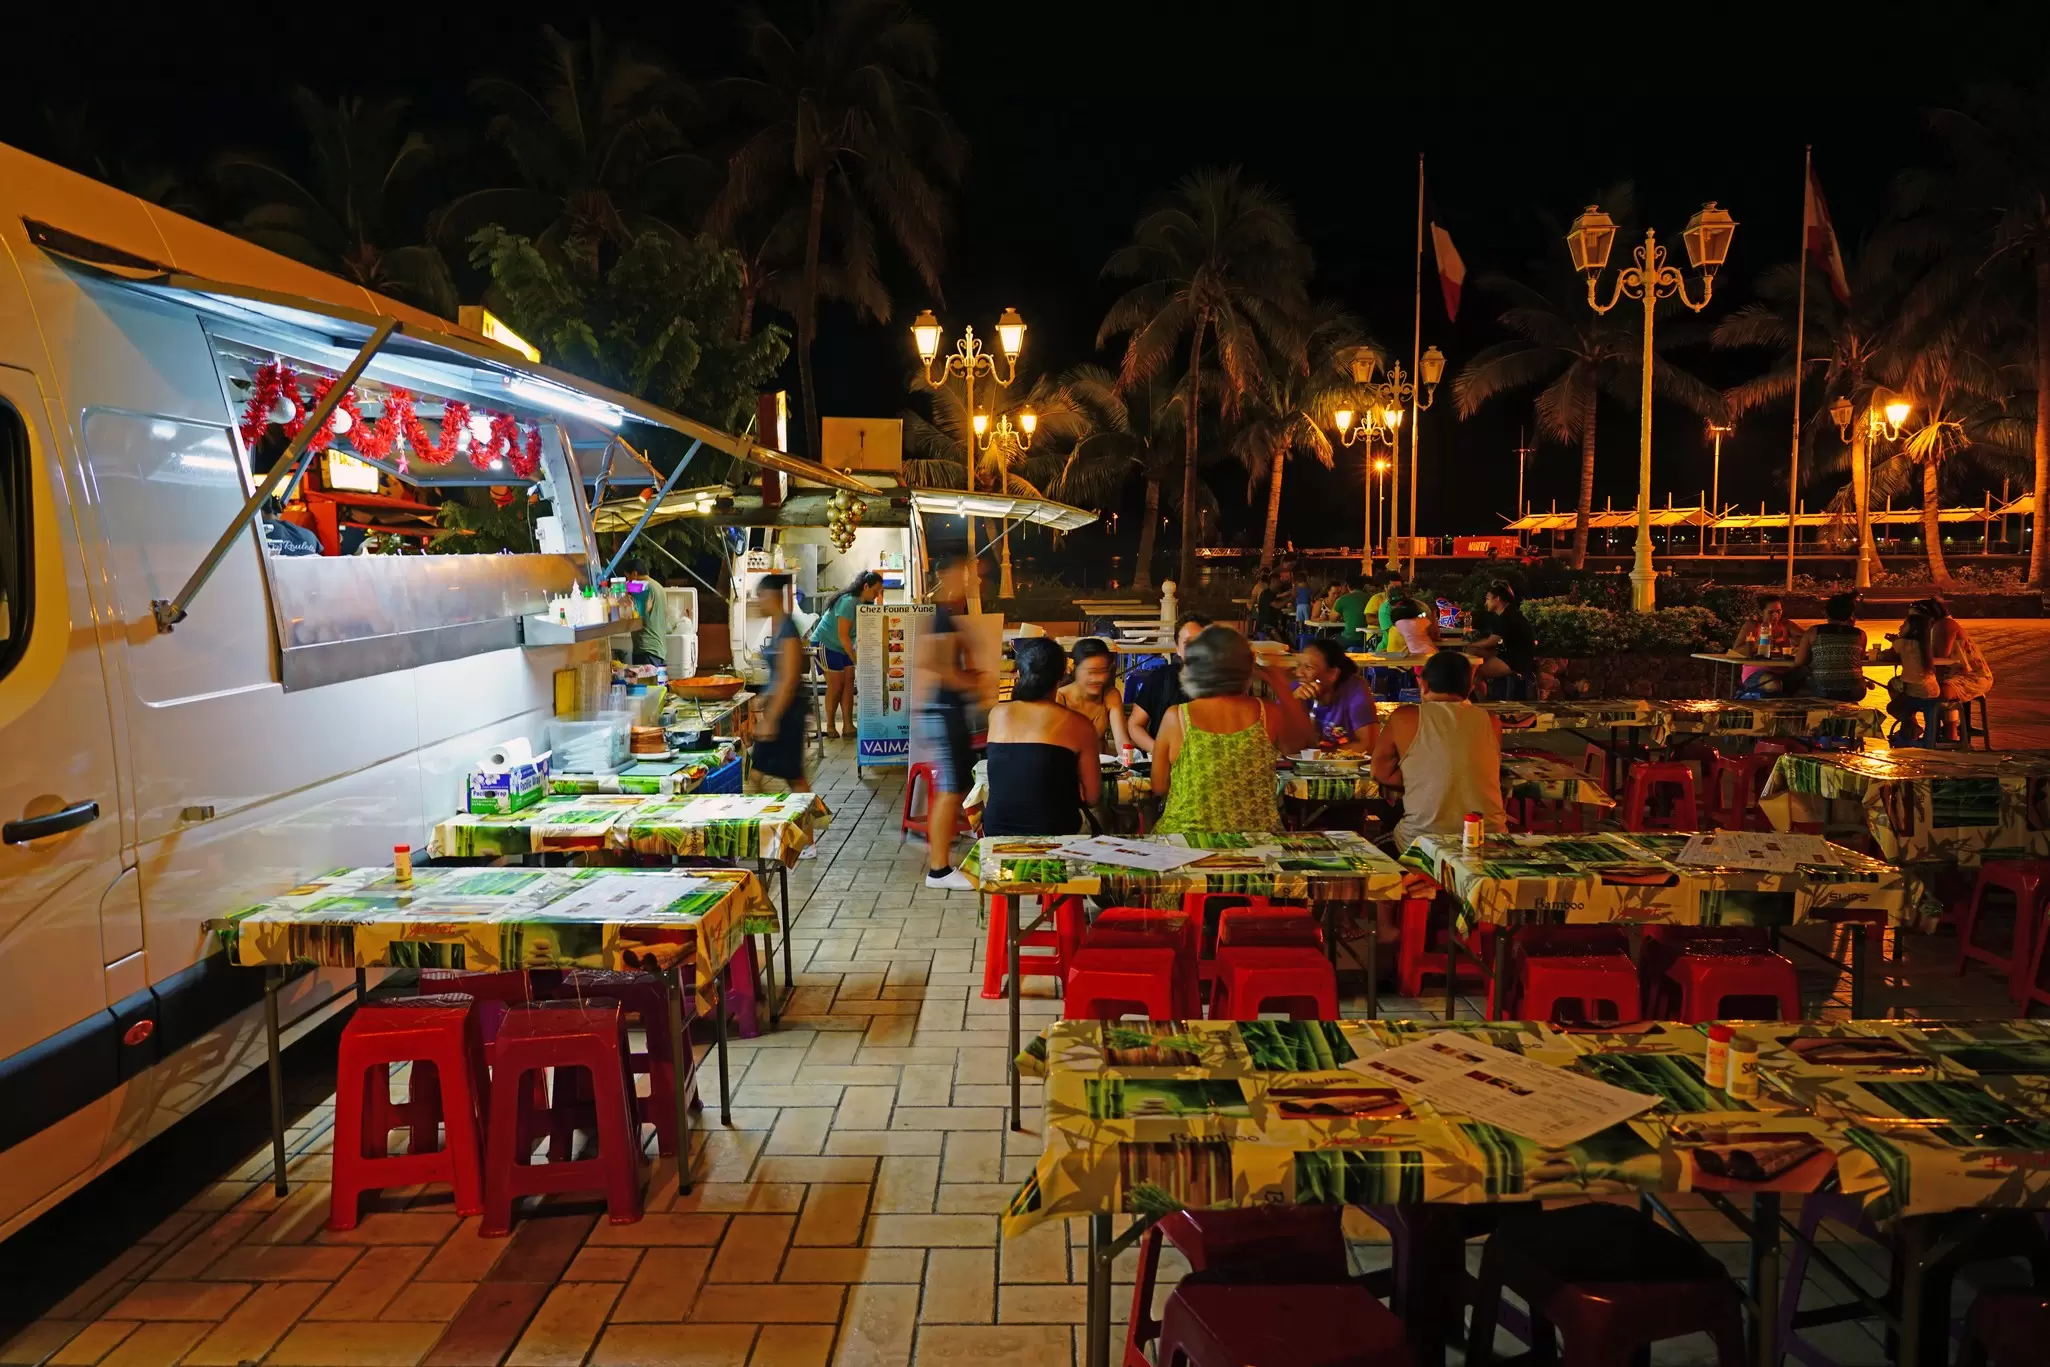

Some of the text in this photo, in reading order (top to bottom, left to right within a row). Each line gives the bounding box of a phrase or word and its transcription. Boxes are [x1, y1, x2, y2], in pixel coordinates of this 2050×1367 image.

[860, 605, 935, 614] Chez Foung Yune
[1534, 897, 1585, 910] Bamboo
[1169, 1132, 1260, 1143] Bamboo
